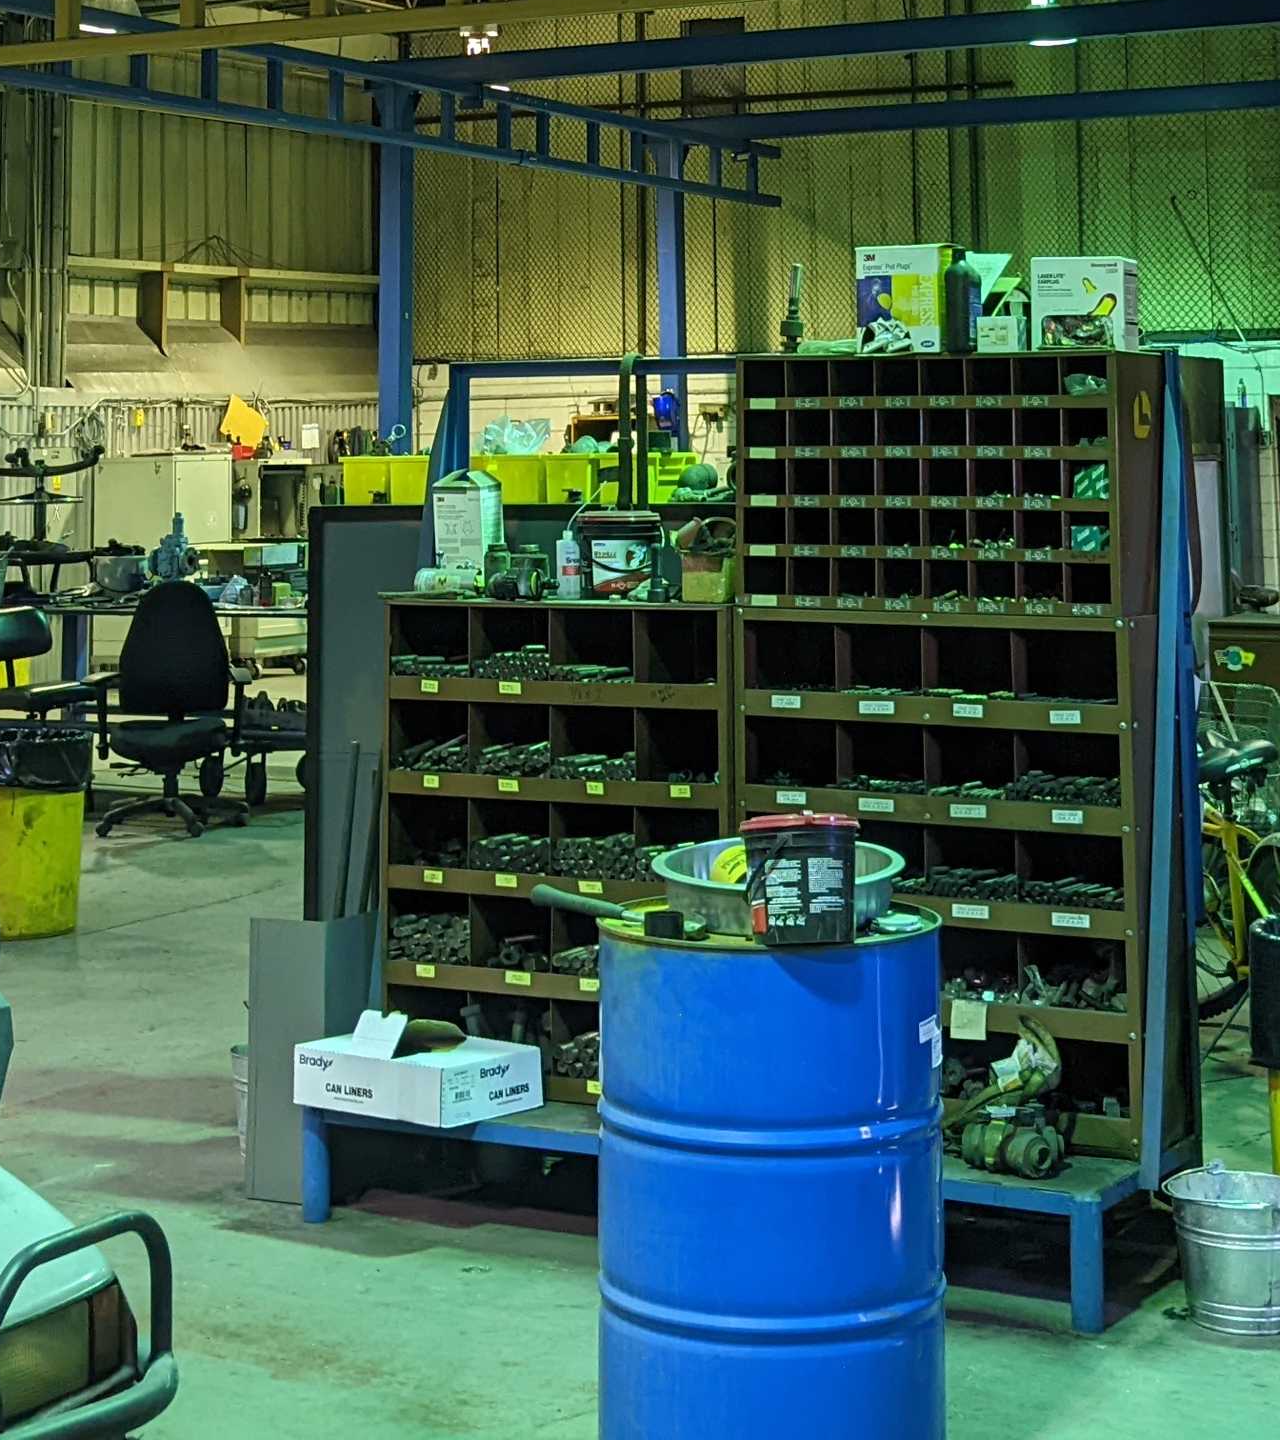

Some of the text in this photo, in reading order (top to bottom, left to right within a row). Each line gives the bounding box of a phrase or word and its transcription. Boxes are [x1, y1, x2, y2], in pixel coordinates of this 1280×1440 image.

[863, 254, 876, 262] 3M
[325, 1082, 373, 1099] CAN LINERS
[488, 1082, 530, 1101] CAN LINERS
